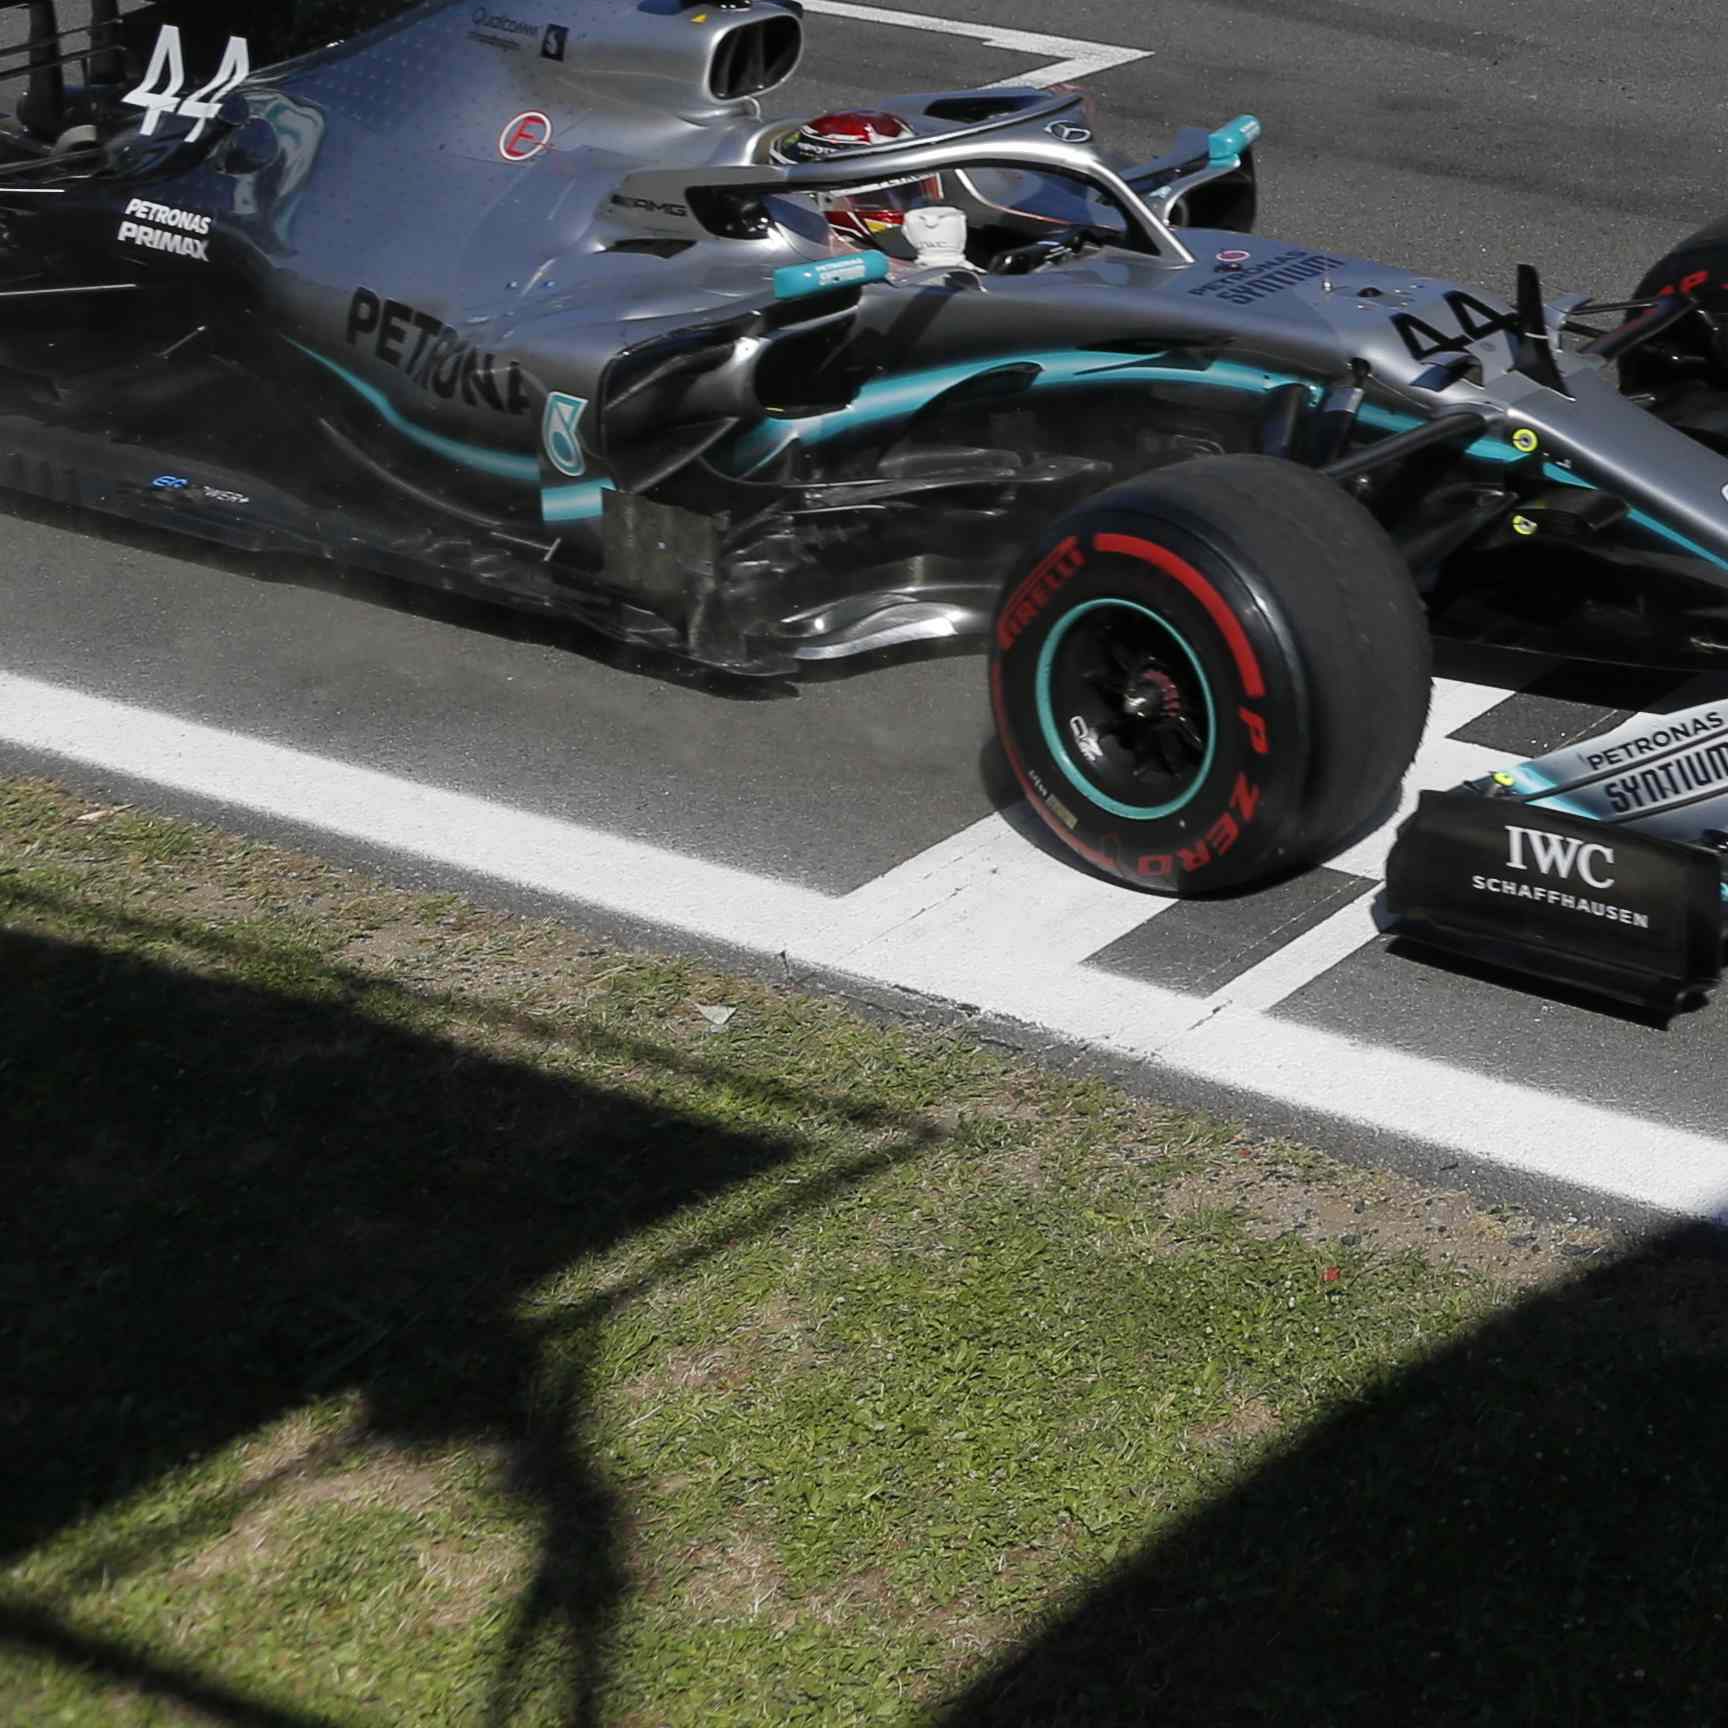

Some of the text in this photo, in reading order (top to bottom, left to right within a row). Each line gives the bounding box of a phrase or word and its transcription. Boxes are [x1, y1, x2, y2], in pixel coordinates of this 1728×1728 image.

[120, 23, 250, 144] 44
[117, 221, 210, 262] PRIMAX
[125, 198, 212, 235] PETRONAS
[1216, 255, 1345, 305] SYNTIUM
[1389, 290, 1522, 362] 44
[998, 534, 1087, 651] PIRELLI
[1586, 711, 1724, 771] PETRONAS
[1134, 704, 1270, 877] P ZERO
[1504, 824, 1616, 889] IWC
[1472, 874, 1649, 929] SCHAFFHAUSEN
